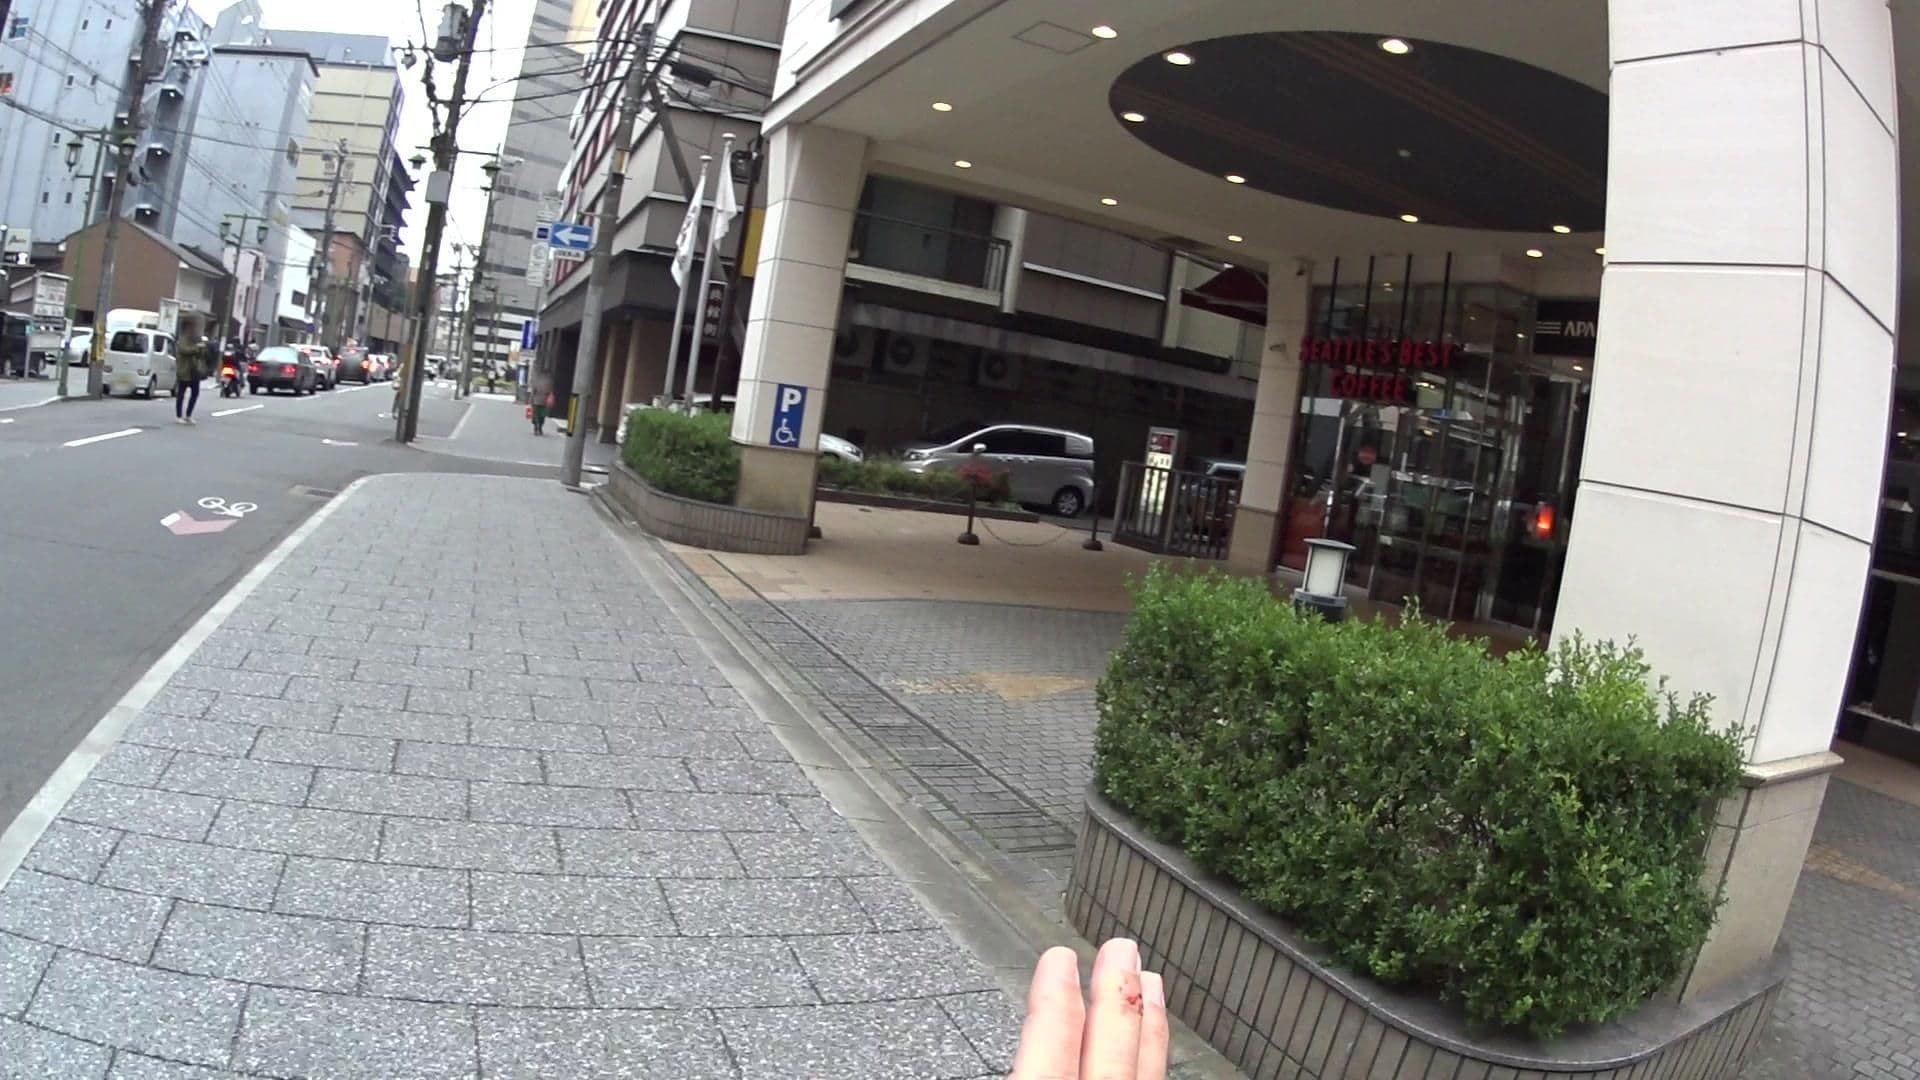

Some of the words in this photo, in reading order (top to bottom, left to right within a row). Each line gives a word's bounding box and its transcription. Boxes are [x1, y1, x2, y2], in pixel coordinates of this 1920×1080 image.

[1564, 320, 1596, 338] APA
[1300, 336, 1393, 366] SEATTLE'S
[1399, 339, 1455, 368] BEST
[1330, 369, 1407, 399] COFFEE
[780, 387, 802, 413] P
